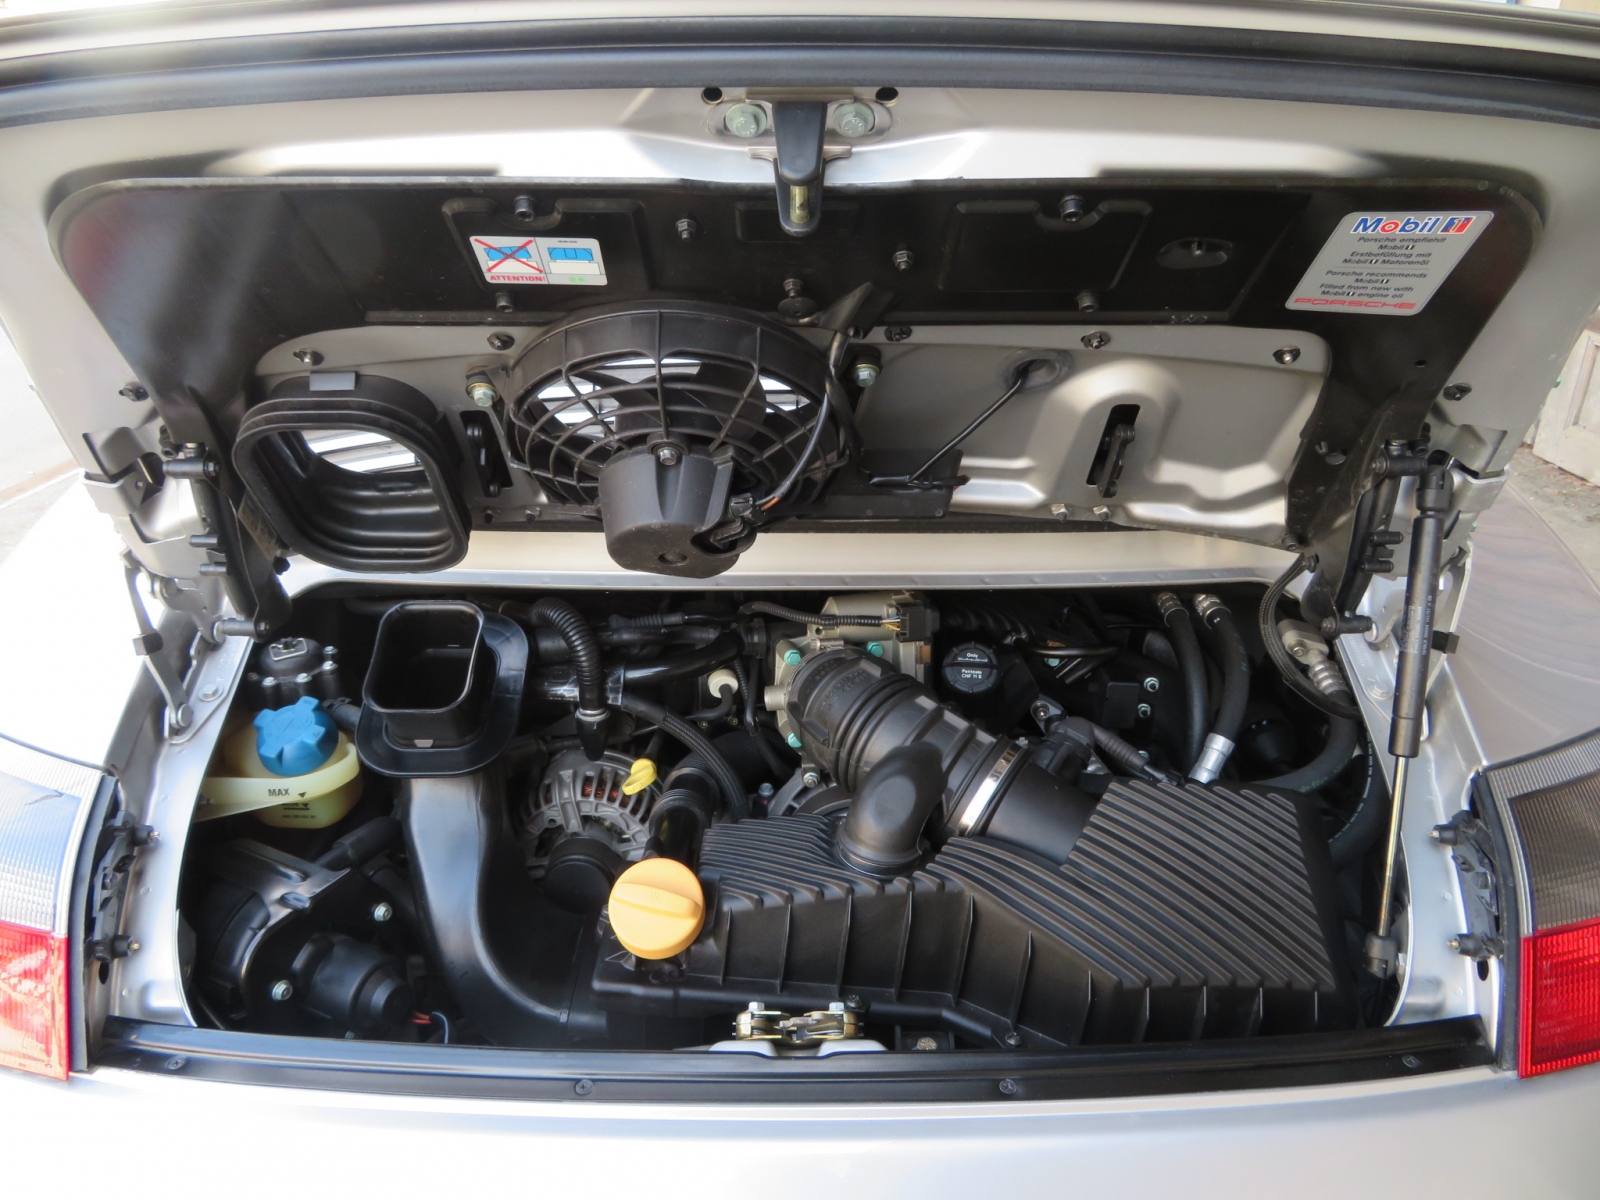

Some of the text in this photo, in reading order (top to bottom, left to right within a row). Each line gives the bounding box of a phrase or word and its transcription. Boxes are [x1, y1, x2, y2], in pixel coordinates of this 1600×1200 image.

[1350, 216, 1442, 234] Mobil
[1350, 251, 1413, 259] Erstbefüllung
[1365, 271, 1427, 279] recommends
[1357, 291, 1390, 299] engine
[1294, 297, 1416, 310] PORSCHE
[268, 788, 290, 797] MAX
